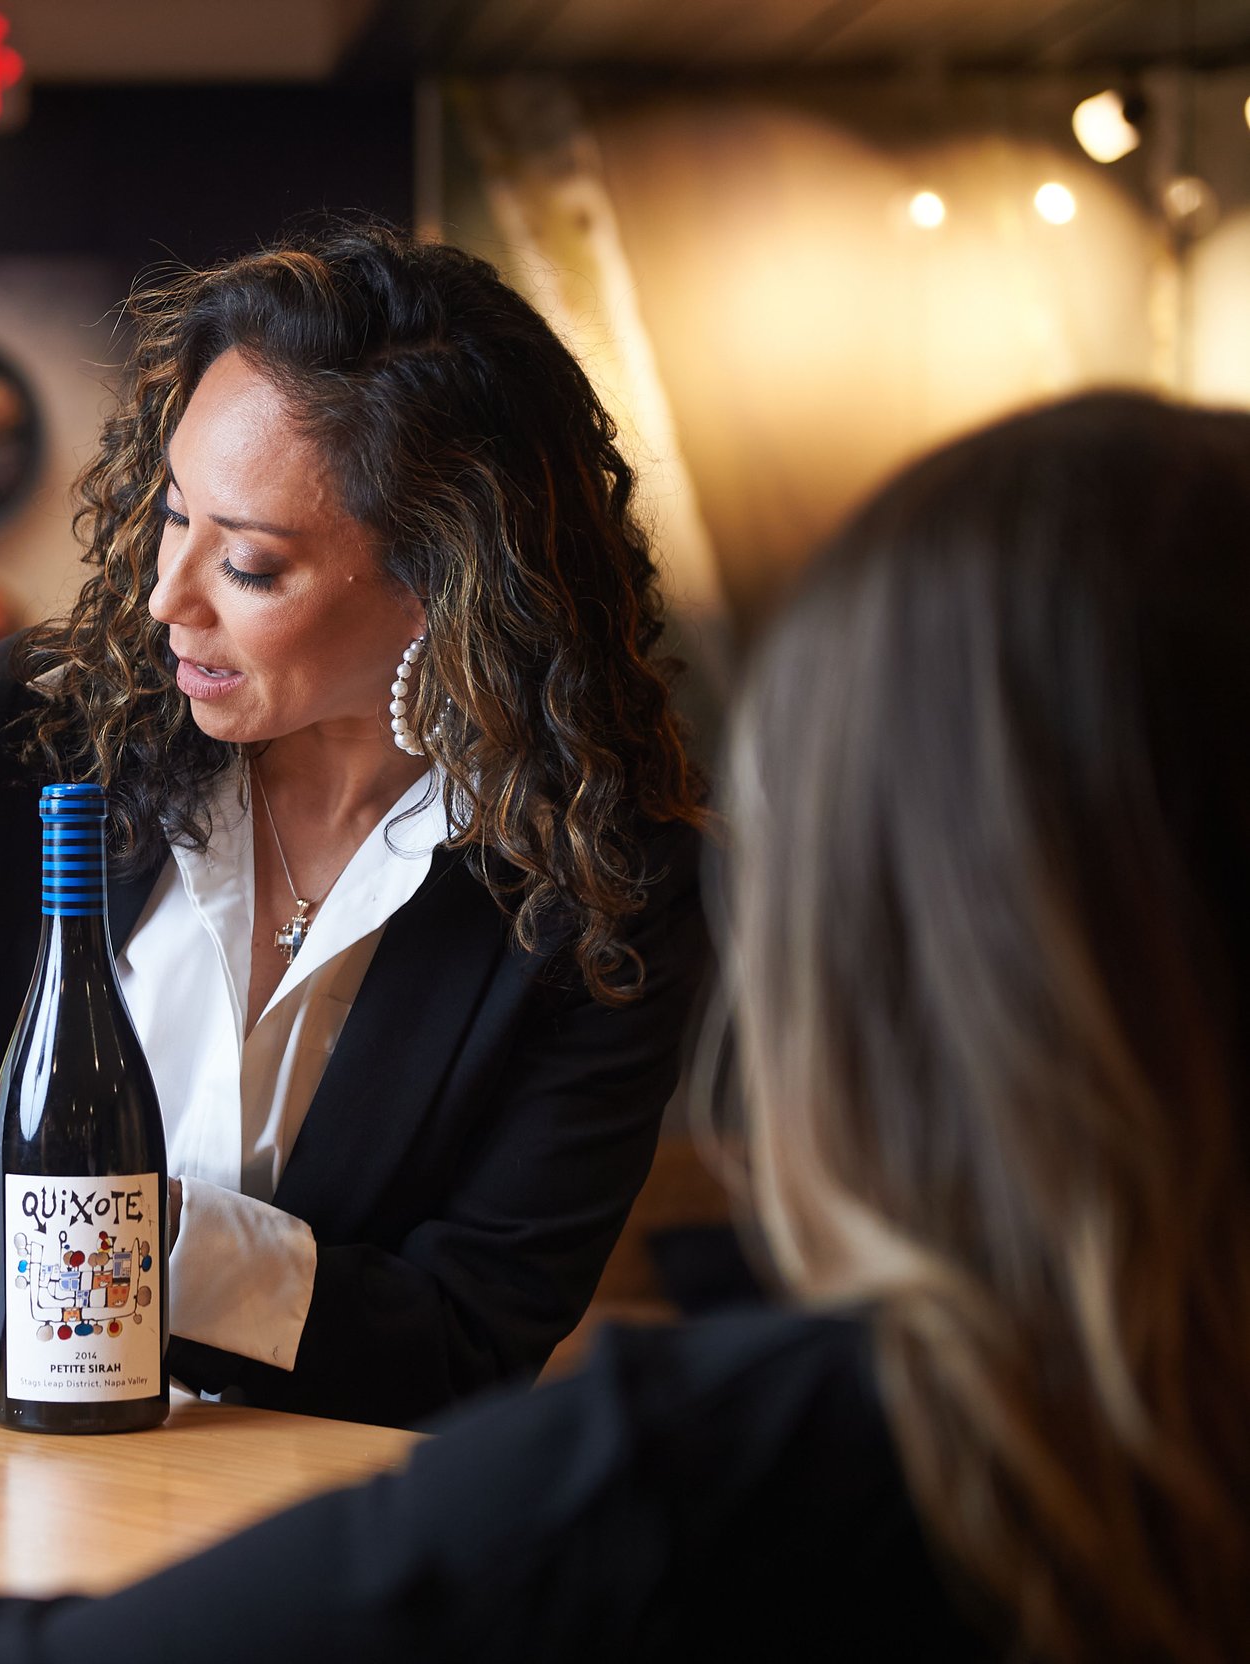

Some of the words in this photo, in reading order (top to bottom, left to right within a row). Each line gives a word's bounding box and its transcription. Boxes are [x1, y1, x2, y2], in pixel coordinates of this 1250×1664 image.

[75, 1352, 98, 1360] 2014
[50, 1364, 86, 1373] PETITE
[89, 1364, 121, 1373] SIRAH
[20, 1378, 41, 1388] Stags
[44, 1379, 64, 1389] Leap
[67, 1379, 102, 1389] District,
[104, 1378, 126, 1388] Napa
[128, 1377, 148, 1386] Valley
